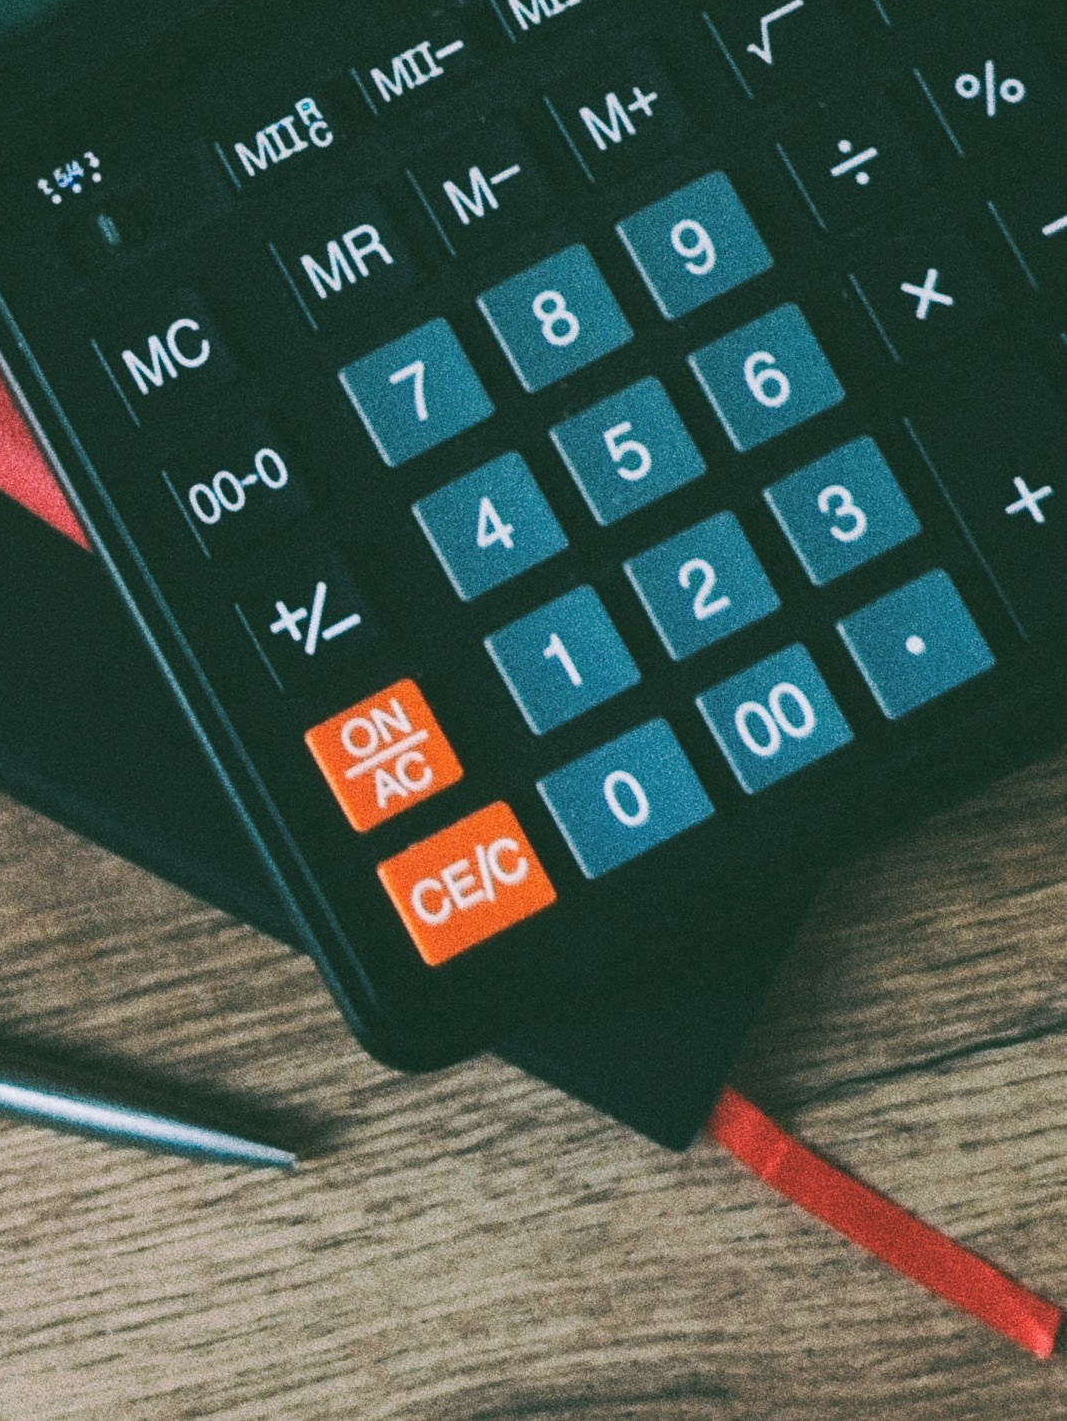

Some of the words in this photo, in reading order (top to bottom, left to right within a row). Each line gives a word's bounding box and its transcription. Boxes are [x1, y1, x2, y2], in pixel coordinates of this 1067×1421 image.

[579, 87, 657, 150] M+
[300, 224, 394, 299] MR
[670, 219, 717, 275] 9
[532, 290, 581, 347] 8
[121, 318, 211, 394] MC
[743, 351, 792, 409] 6
[388, 360, 430, 422] 7
[602, 420, 653, 482] 5
[188, 448, 289, 525] 00-0
[817, 484, 868, 543] 3
[475, 496, 515, 549] 4
[677, 557, 731, 621] 2
[543, 633, 583, 686] 1
[339, 698, 414, 759] ON
[734, 681, 817, 758] 00
[373, 751, 434, 809] AC
[602, 770, 651, 828] 0
[410, 837, 529, 926] CE/C
